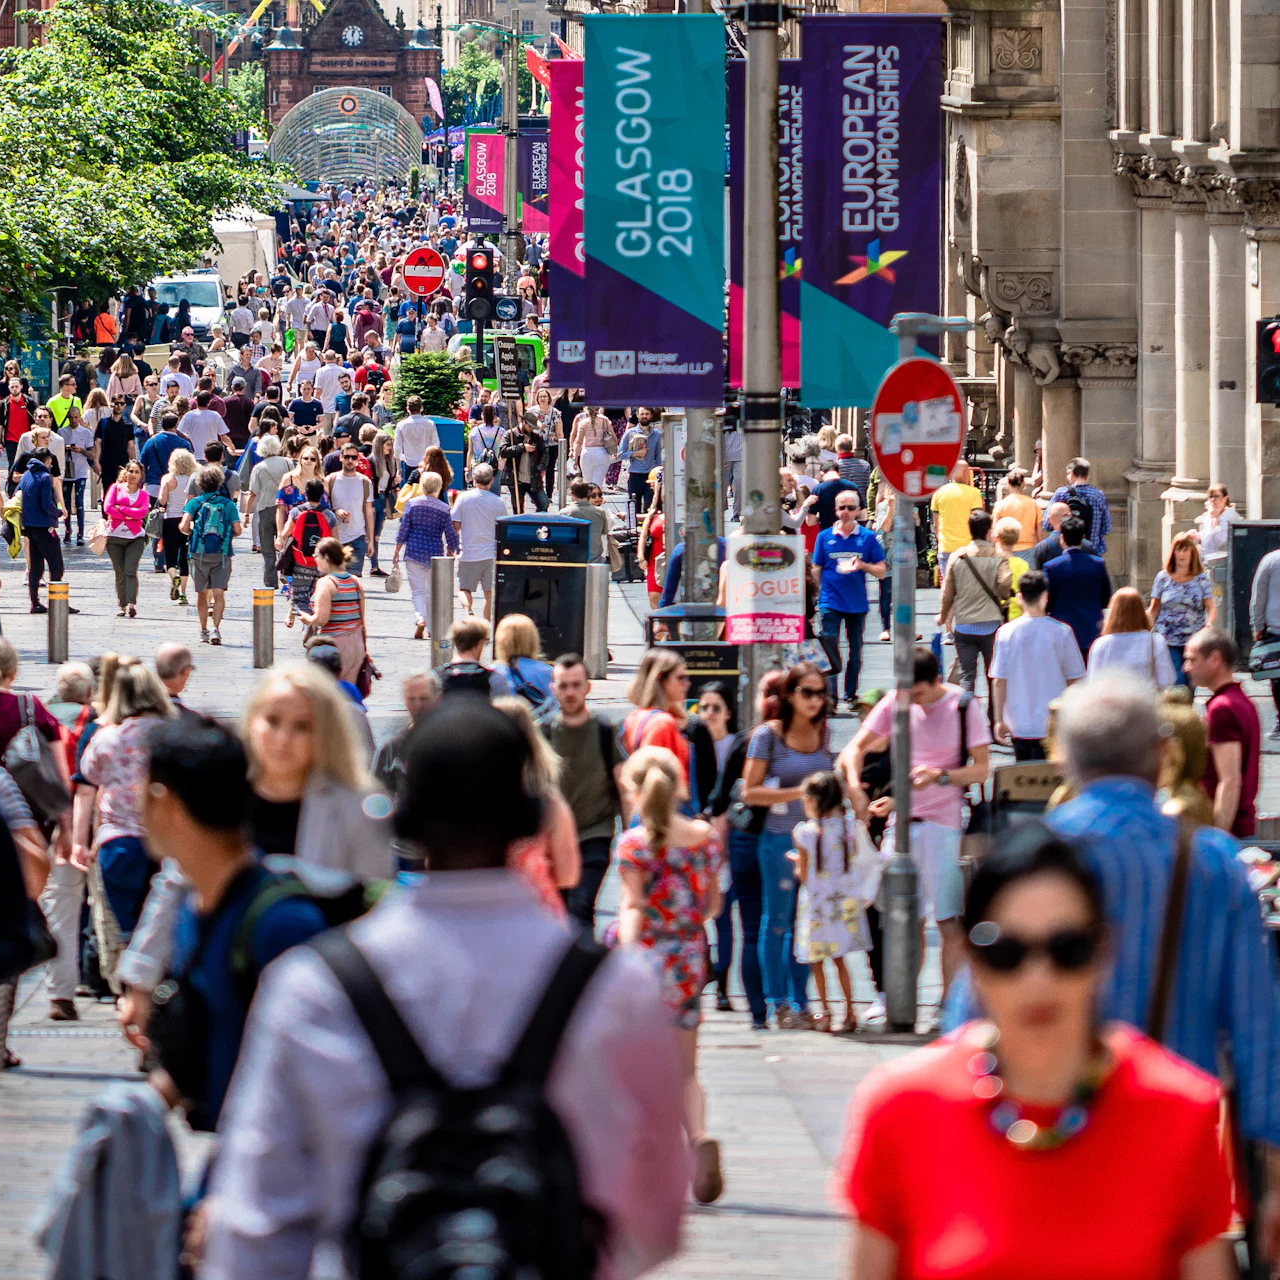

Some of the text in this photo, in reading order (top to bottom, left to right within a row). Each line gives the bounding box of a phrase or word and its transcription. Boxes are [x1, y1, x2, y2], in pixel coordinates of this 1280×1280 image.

[843, 45, 875, 232] EUROPEAN
[877, 45, 900, 232] CHAMPIONSHIPS
[615, 46, 652, 258] GLASGOW
[476, 142, 487, 196] GLASGOW
[532, 142, 541, 190] EUROPEAN
[486, 172, 497, 196] 2018
[656, 168, 693, 257] 2018
[498, 341, 515, 350] Cheaper
[501, 352, 514, 360] Apple
[637, 351, 679, 364] Harper
[501, 364, 516, 373] Repairs
[599, 355, 631, 370] HM
[637, 363, 714, 375] Macleod LLP
[729, 577, 801, 606] VOGUE
